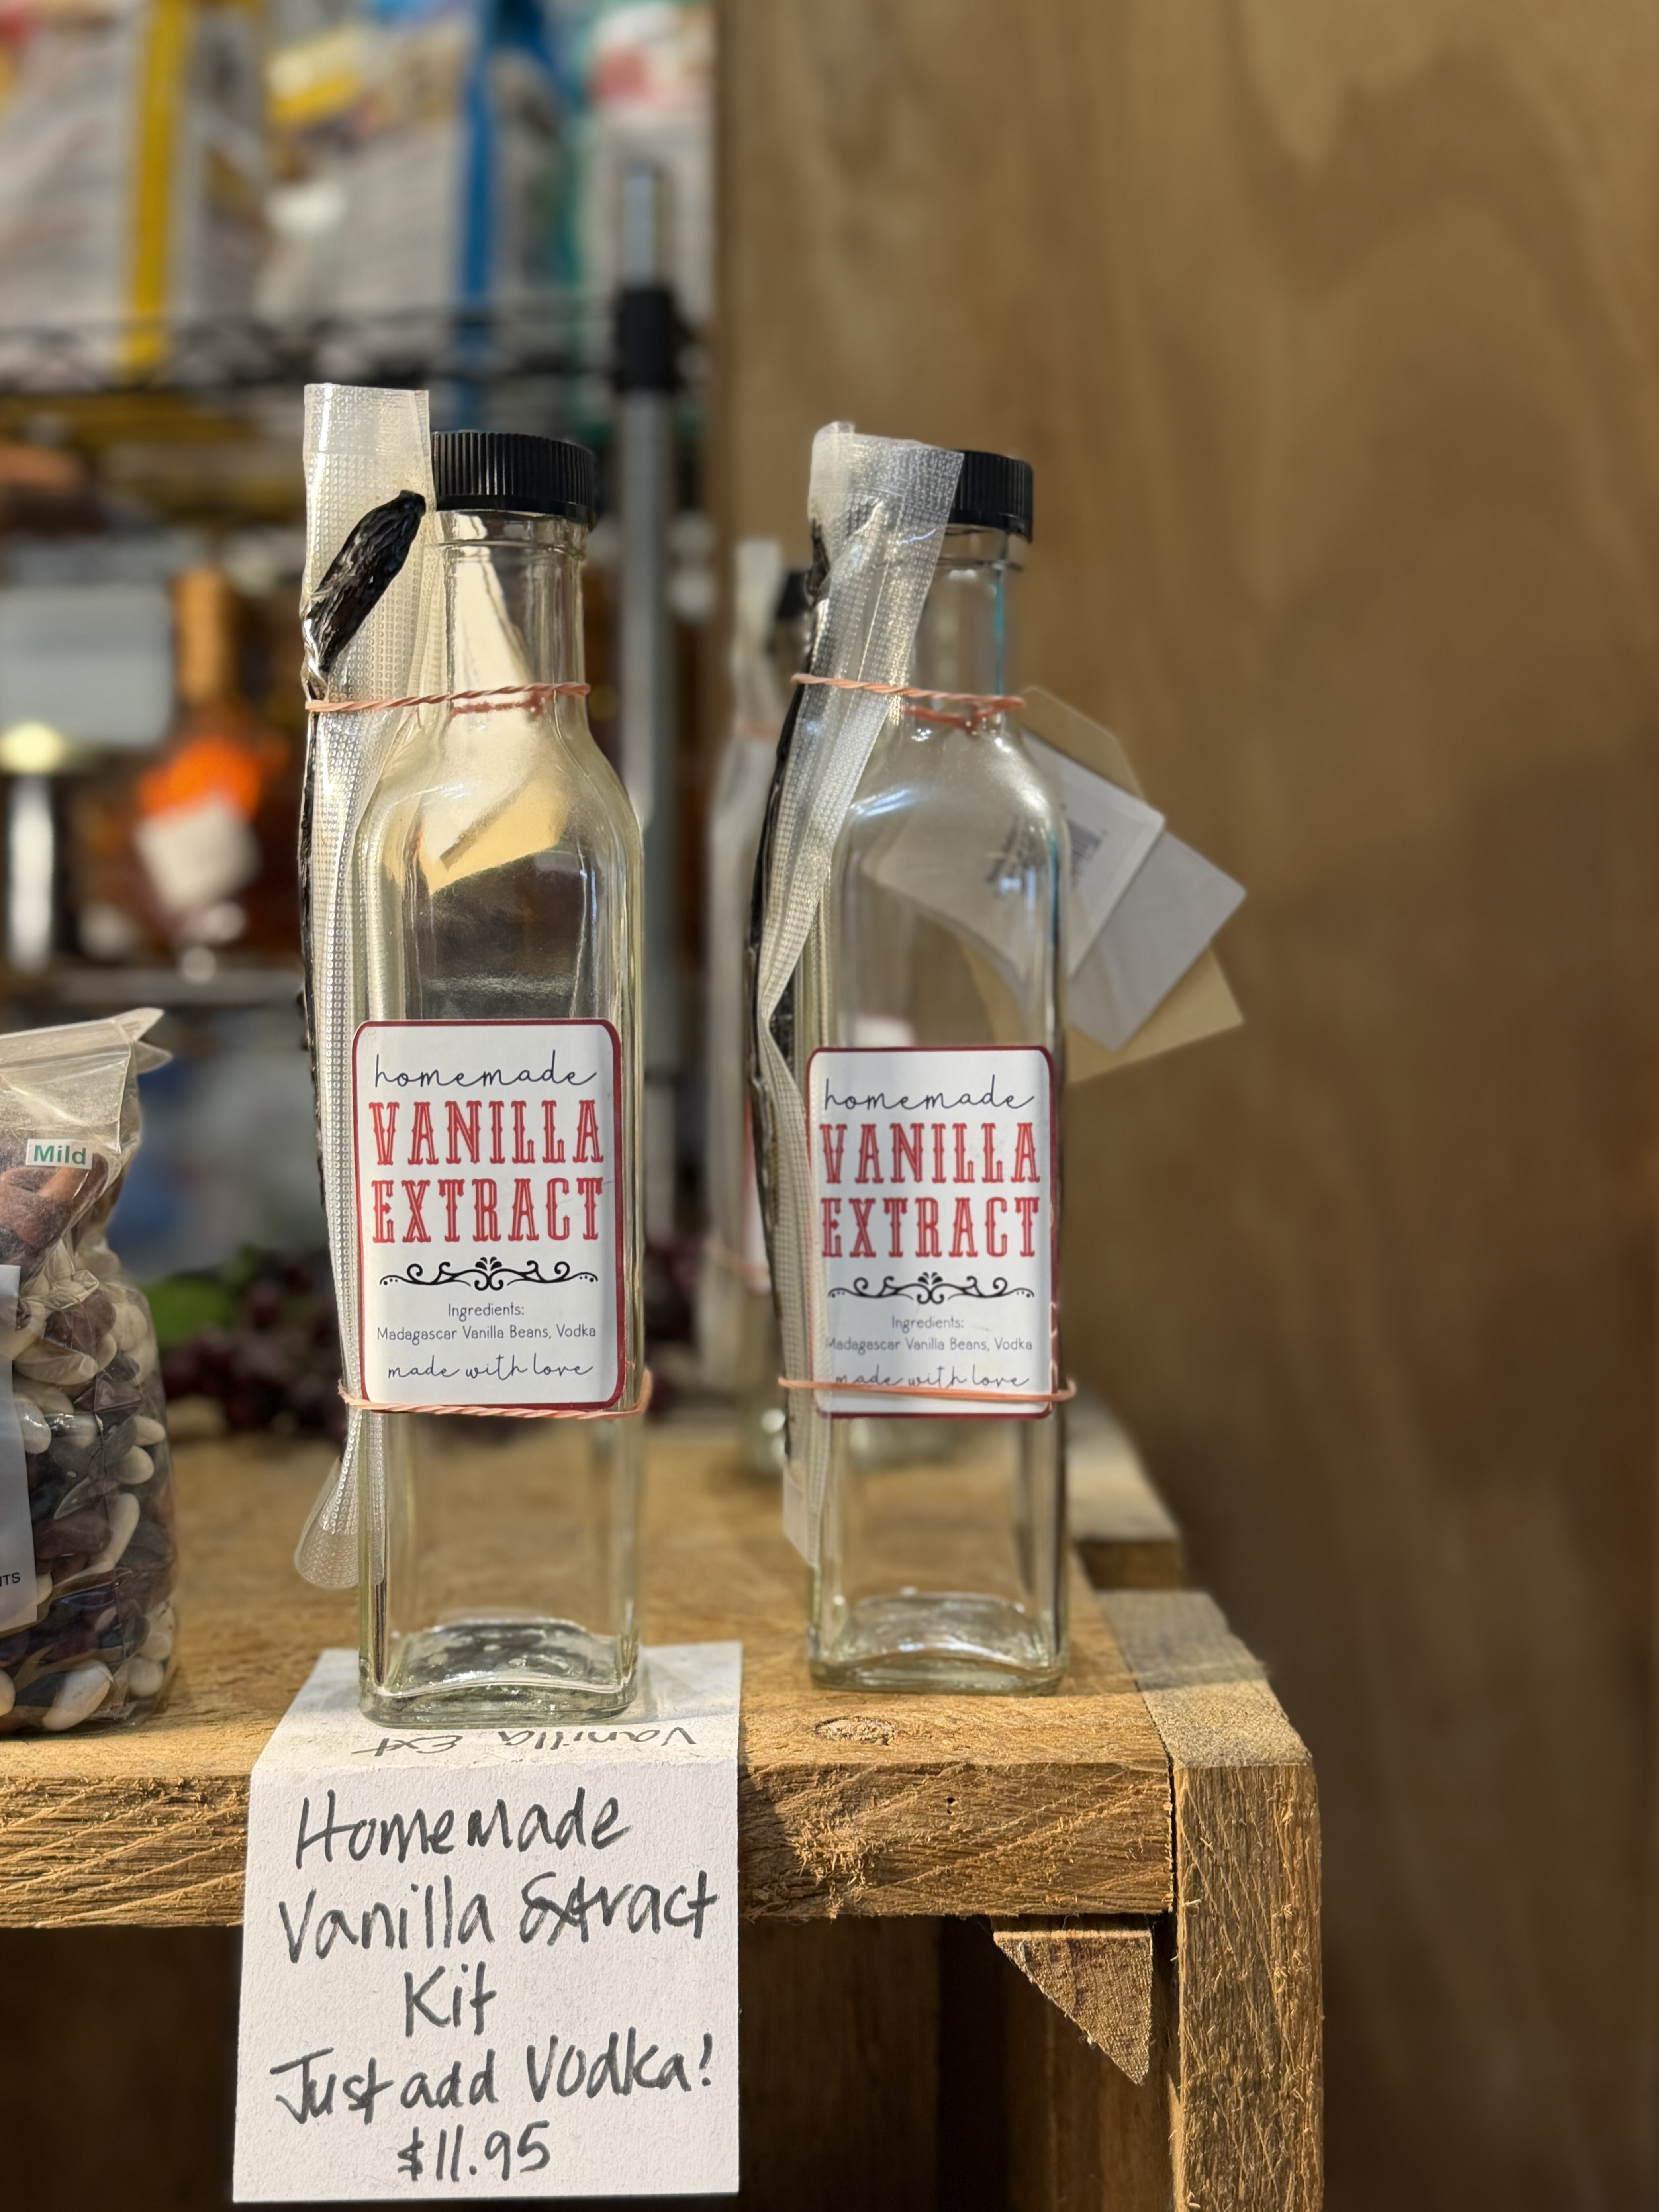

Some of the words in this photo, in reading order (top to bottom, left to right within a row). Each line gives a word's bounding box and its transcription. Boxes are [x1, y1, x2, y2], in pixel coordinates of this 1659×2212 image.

[375, 1050, 597, 1087] homemade
[825, 1074, 1035, 1110] homemade
[368, 1099, 603, 1165] VANILLA
[34, 1145, 86, 1165] Mild
[819, 1123, 1041, 1184] VANILLA
[371, 1177, 603, 1243] EXTRACT
[821, 1196, 1040, 1258] EXTRACT
[449, 1302, 524, 1321] Ingredients:
[891, 1315, 964, 1333] Ingredients:
[377, 1327, 457, 1345] Madagascar
[462, 1325, 504, 1339] Vanilla
[510, 1324, 551, 1339] Beans,
[556, 1324, 596, 1337] Vodka
[904, 1337, 944, 1350] Vanilla
[950, 1337, 989, 1352] Beans,
[994, 1337, 1033, 1350] Vodka
[388, 1355, 460, 1378] made
[465, 1354, 528, 1381] with
[533, 1352, 593, 1377] love
[836, 1364, 903, 1386] made
[908, 1365, 967, 1389] with
[972, 1364, 1030, 1387] love
[498, 1727, 697, 1750] Vanilla
[278, 1875, 495, 1964] Vanilla
[519, 1870, 719, 1946] Extract
[404, 1961, 497, 2037] Kit
[270, 2048, 394, 2124] Just
[400, 2049, 499, 2109] add
[527, 2027, 713, 2102] Vodka!
[397, 2120, 550, 2182] $11.95
